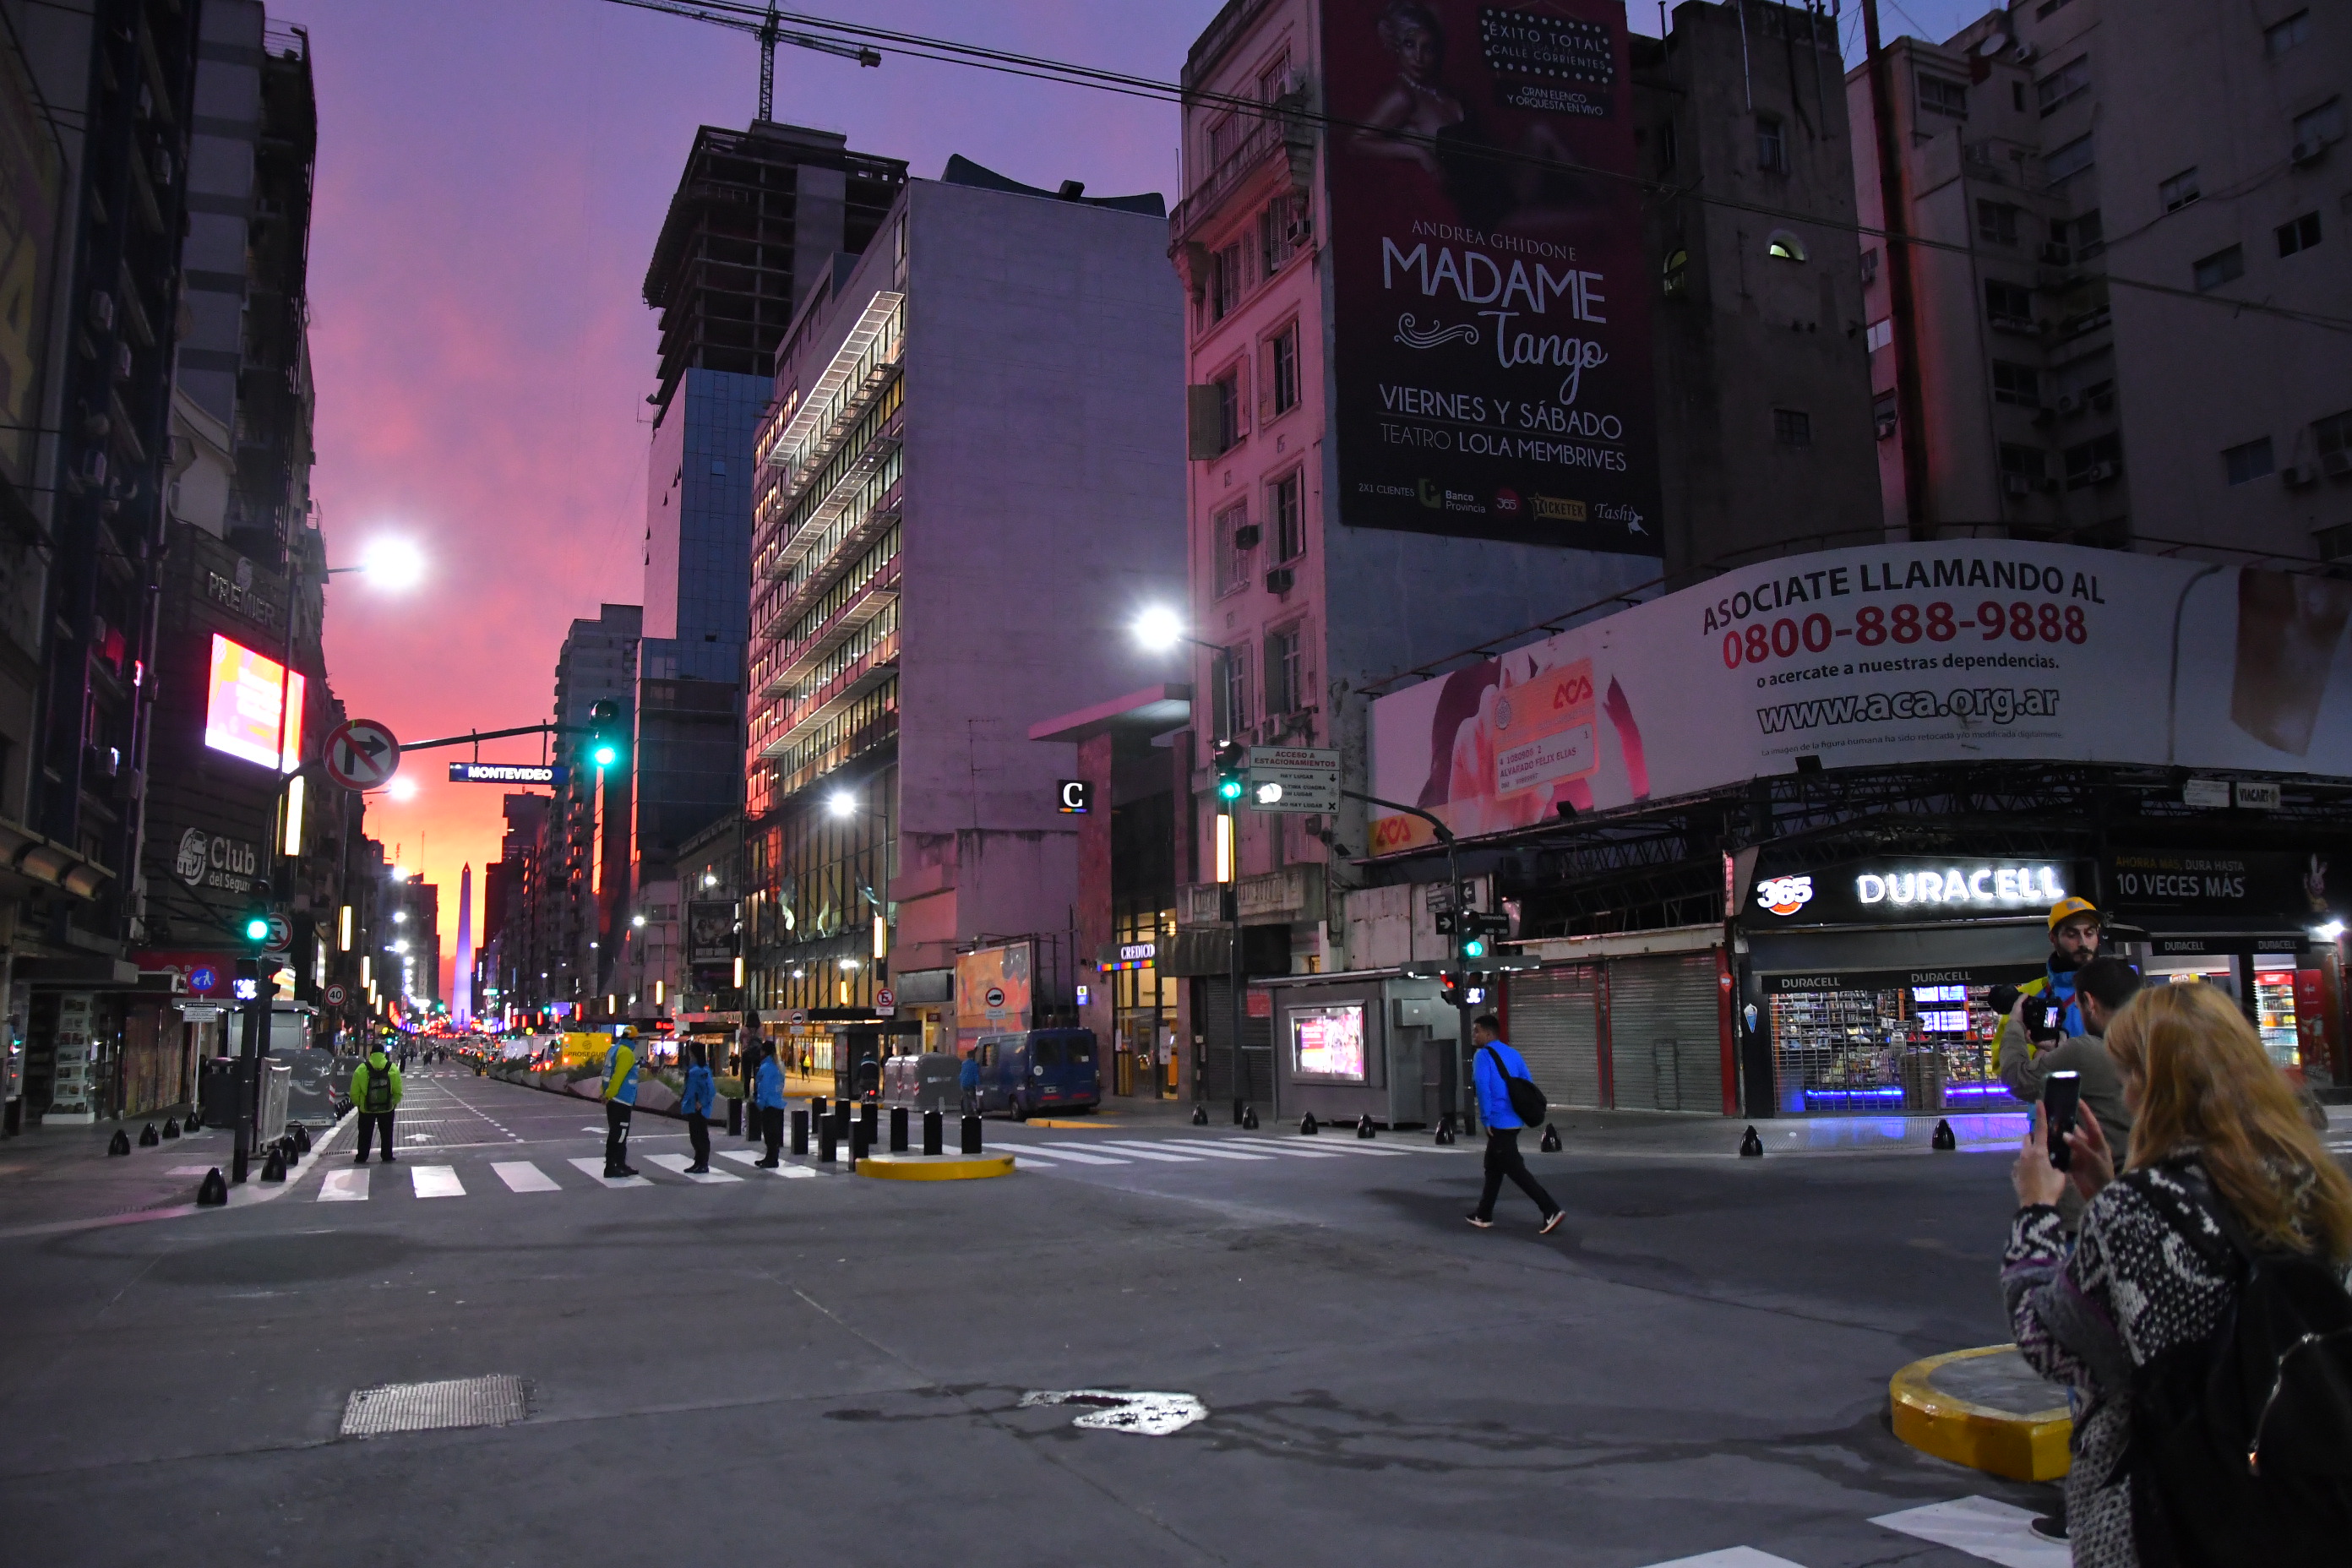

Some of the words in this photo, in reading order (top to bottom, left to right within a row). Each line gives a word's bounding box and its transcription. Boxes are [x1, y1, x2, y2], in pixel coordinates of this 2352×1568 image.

[1549, 33, 1603, 52] TOTAL
[1492, 44, 1527, 58] CALLE
[1534, 51, 1605, 70] CORRIENTES
[1507, 95, 1514, 104] Y
[1516, 95, 1565, 112] ORQUESTA
[1567, 101, 1580, 113] EN
[1582, 105, 1603, 117] VIVO
[1522, 86, 1548, 99] GRAN
[1549, 90, 1587, 103] ELENCO
[1413, 219, 1485, 246] ANDREA
[1490, 233, 1576, 262] GHIDONE
[1382, 237, 1607, 324] MADAME
[1478, 310, 1609, 406] Tango
[1379, 384, 1486, 422] VIERNES
[1494, 399, 1511, 424] Y
[1519, 400, 1622, 439] SÁBADO
[1380, 422, 1451, 449] TEATRO
[1460, 432, 1512, 458] LOLA
[1517, 438, 1627, 471] MEMBRIVES
[1358, 483, 1374, 493] 2X1
[1376, 485, 1415, 497] CLIENTES
[1446, 490, 1474, 502] Banco
[1446, 500, 1487, 514] Provincia
[1497, 497, 1517, 510] 365
[209, 571, 275, 625] PREMIER
[1703, 566, 1850, 635] ASOCIATE
[1860, 558, 2065, 594] LLAMANDO
[2072, 572, 2106, 605] AL
[1723, 601, 2088, 670] 0800-888-9888
[1756, 675, 1766, 688] o
[1770, 662, 1840, 685] acercate
[1843, 662, 1854, 676] a
[1859, 656, 1938, 673] nuestras
[1943, 653, 2060, 672] dependencias.
[1554, 675, 1593, 710] ACA
[1757, 688, 2060, 735] www.aca.org.ar
[1771, 747, 1799, 755] imagen
[1821, 740, 1845, 749] figura
[1847, 737, 1883, 745] humana
[1918, 732, 1955, 741] retocada
[1957, 732, 1970, 740] y/o
[1972, 730, 2016, 738] modificada
[468, 766, 553, 781] MONTEVIDEO
[1255, 757, 1337, 767] ESTACIONAMIENTOS
[1500, 760, 1534, 777] ALVARADO
[1535, 754, 1555, 766] FELIX
[1063, 782, 1083, 808] C
[1376, 818, 1412, 847] ACA
[211, 836, 255, 875] Club
[2115, 856, 2158, 868] AHORRA
[2186, 859, 2212, 871] DURA
[2214, 860, 2245, 872] HASTA
[210, 871, 223, 887] del
[1756, 876, 1813, 909] 365
[1857, 867, 2065, 904] DURACELL
[2117, 874, 2137, 896] 10
[2142, 874, 2200, 896] VECES
[1120, 944, 1155, 960] CREDICO
[2164, 941, 2205, 951] DURACELL
[2257, 940, 2297, 950] DURACELL
[1781, 977, 1840, 988] DURACELL
[1911, 972, 1972, 983] DURACELL
[329, 989, 342, 1000] 40
